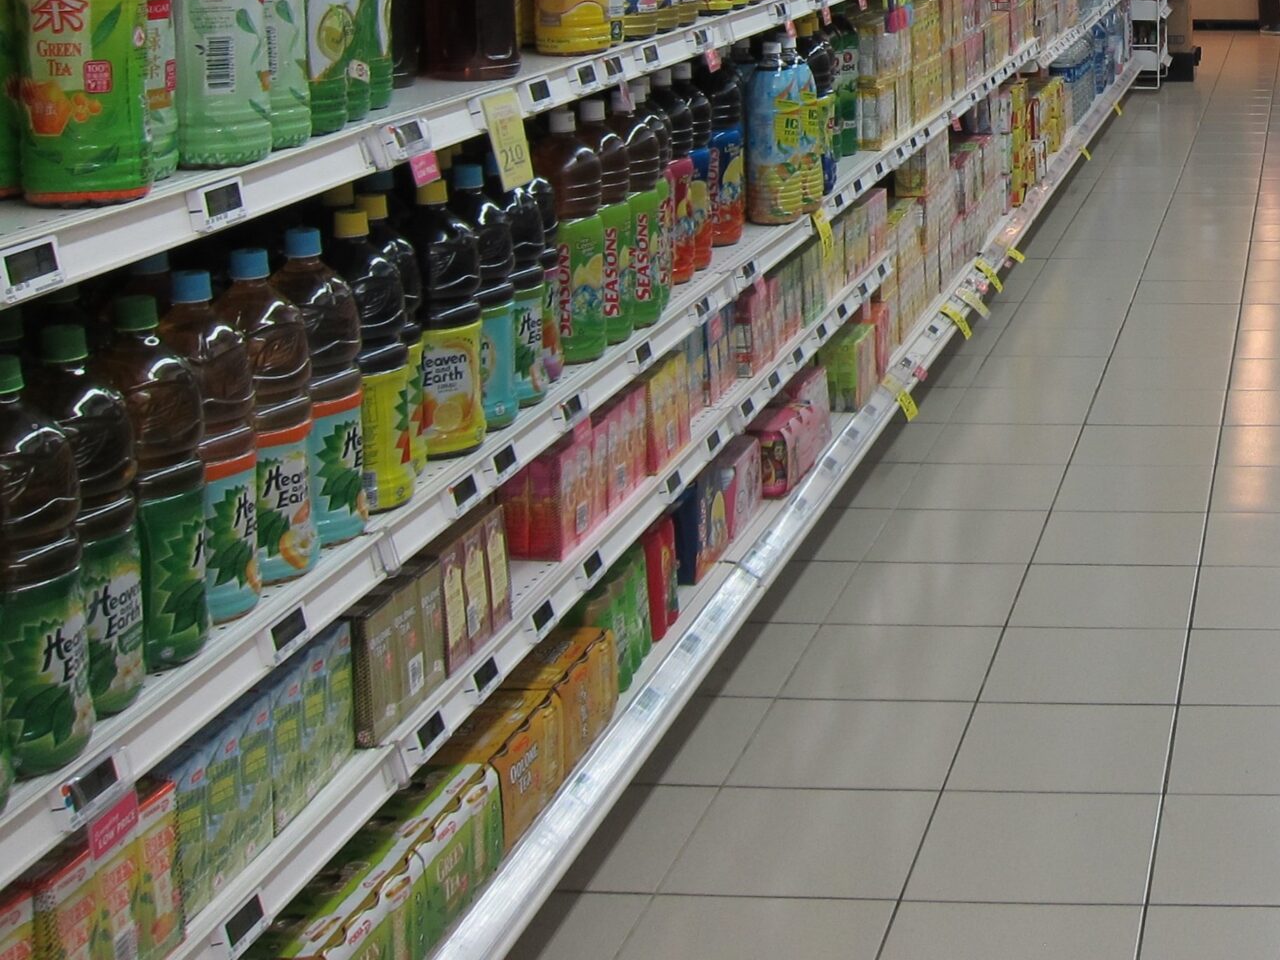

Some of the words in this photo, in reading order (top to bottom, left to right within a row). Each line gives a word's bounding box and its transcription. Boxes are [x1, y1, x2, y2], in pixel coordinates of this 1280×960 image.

[36, 40, 82, 59] GREEN
[47, 59, 73, 78] TEA
[635, 214, 651, 302] SEASONS
[604, 227, 619, 318] SEASONS
[423, 366, 464, 388] Earth
